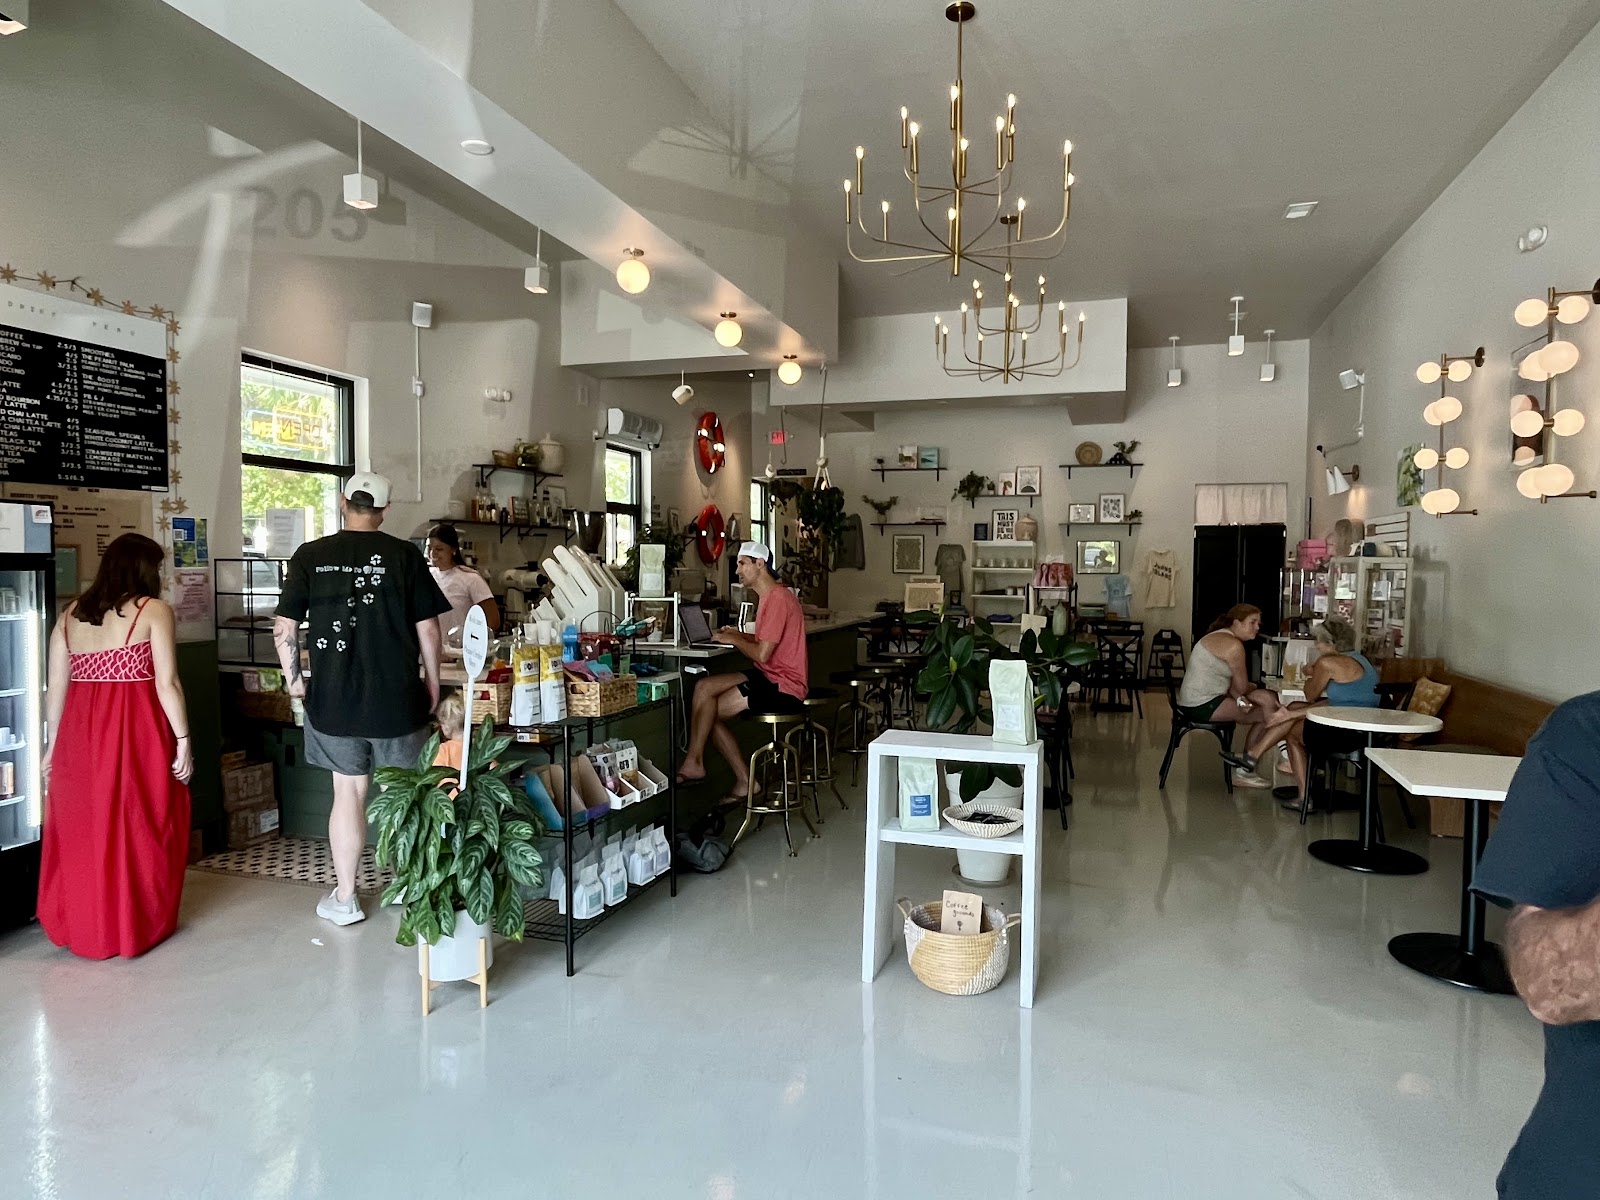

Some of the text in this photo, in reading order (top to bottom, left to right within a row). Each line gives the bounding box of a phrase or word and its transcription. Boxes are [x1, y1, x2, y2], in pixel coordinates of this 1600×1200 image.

[26, 412, 48, 420] LATTE
[996, 512, 1014, 520] THIS
[946, 900, 968, 910] Coffee
